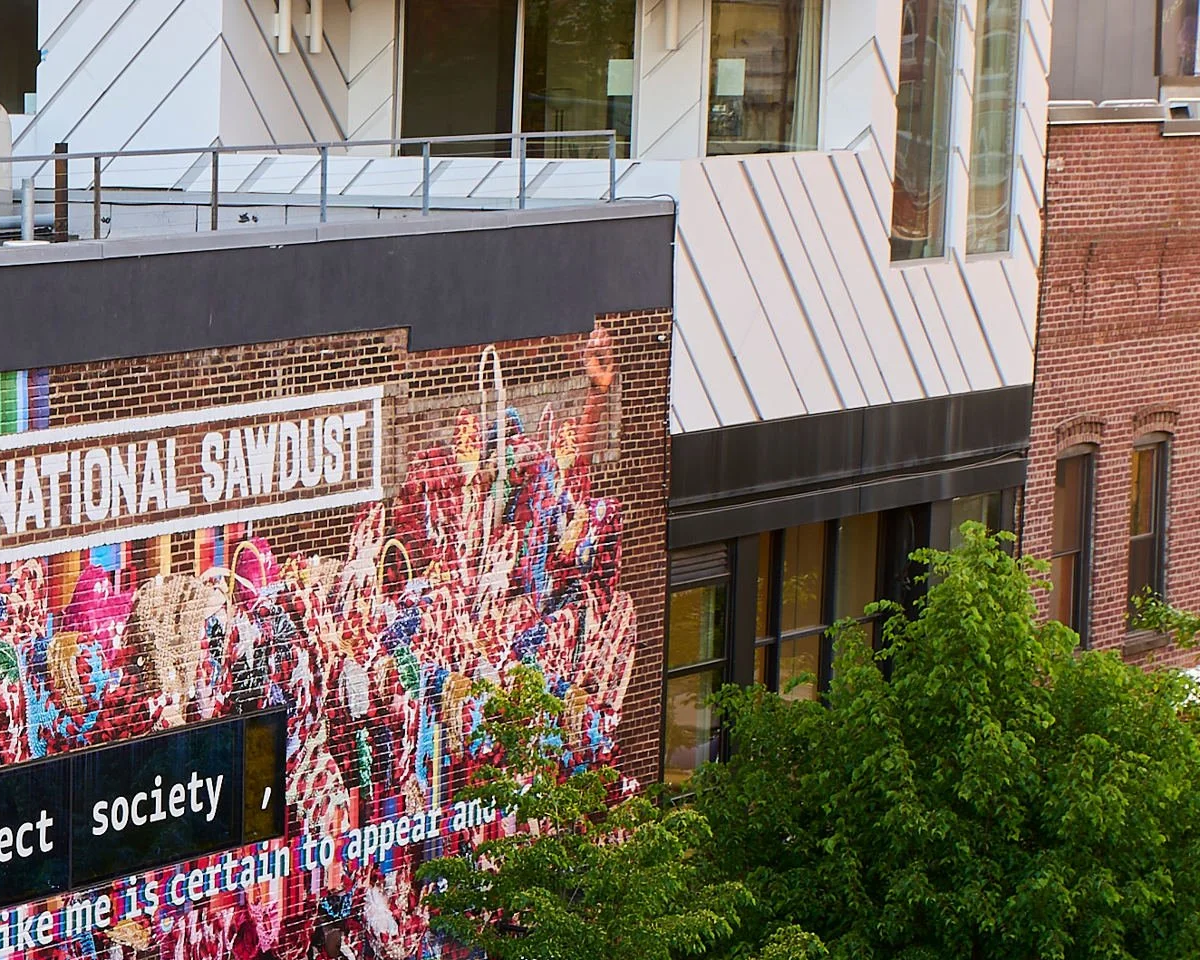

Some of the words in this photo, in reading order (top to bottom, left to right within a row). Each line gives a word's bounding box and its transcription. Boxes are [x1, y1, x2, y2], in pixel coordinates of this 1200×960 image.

[200, 410, 367, 503] SAWDUST
[92, 771, 225, 836] society
[65, 893, 111, 935] me
[126, 875, 159, 919] is
[170, 839, 291, 906] certain
[302, 824, 336, 871] to
[347, 804, 441, 870] appear
